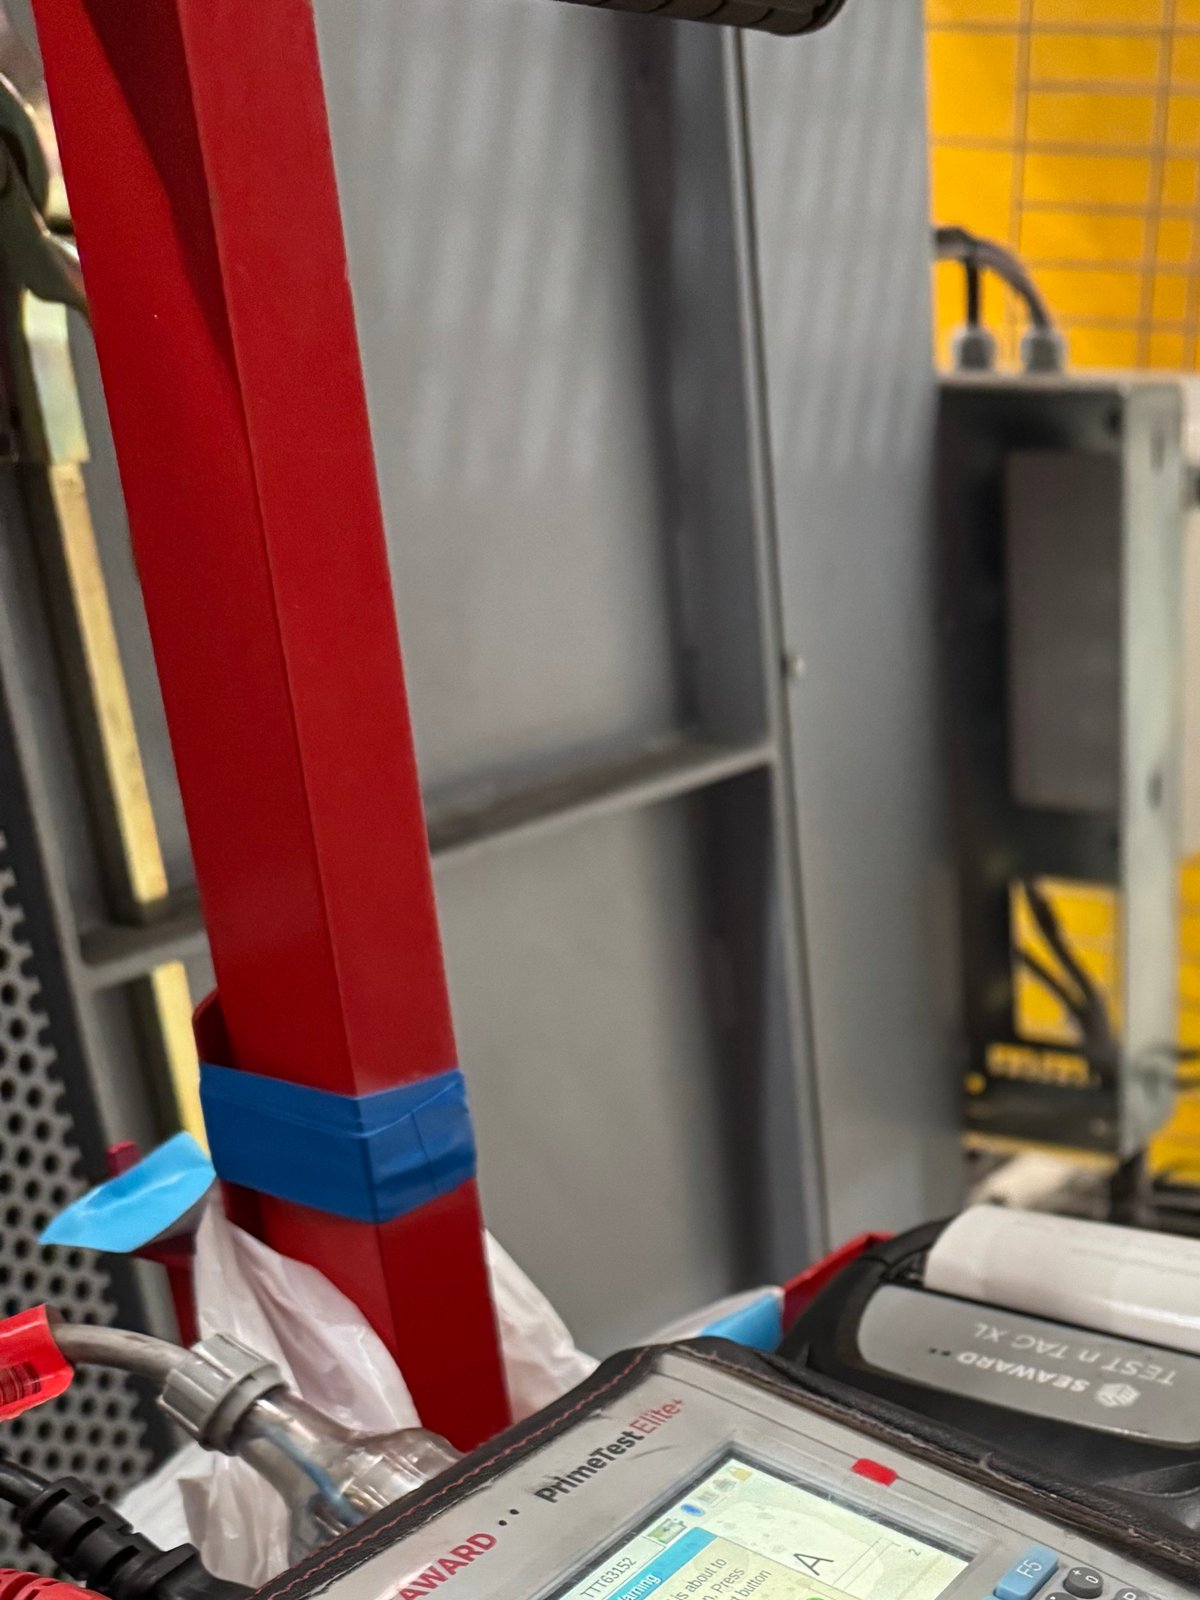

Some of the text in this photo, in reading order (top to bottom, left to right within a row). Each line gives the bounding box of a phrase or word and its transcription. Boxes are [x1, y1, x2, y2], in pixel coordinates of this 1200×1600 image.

[974, 1323, 1008, 1343] XL
[1010, 1334, 1068, 1360] TAG
[956, 1352, 1091, 1392] SEAWARD
[1102, 1357, 1178, 1386] TEST
[579, 1556, 637, 1599] TTT63152
[685, 1567, 717, 1593] about
[710, 1558, 727, 1569] to
[793, 1553, 835, 1577] A
[1015, 1558, 1042, 1579] F5
[711, 1567, 745, 1594] Press
[734, 1570, 772, 1597] button
[1085, 1574, 1100, 1585] 0
